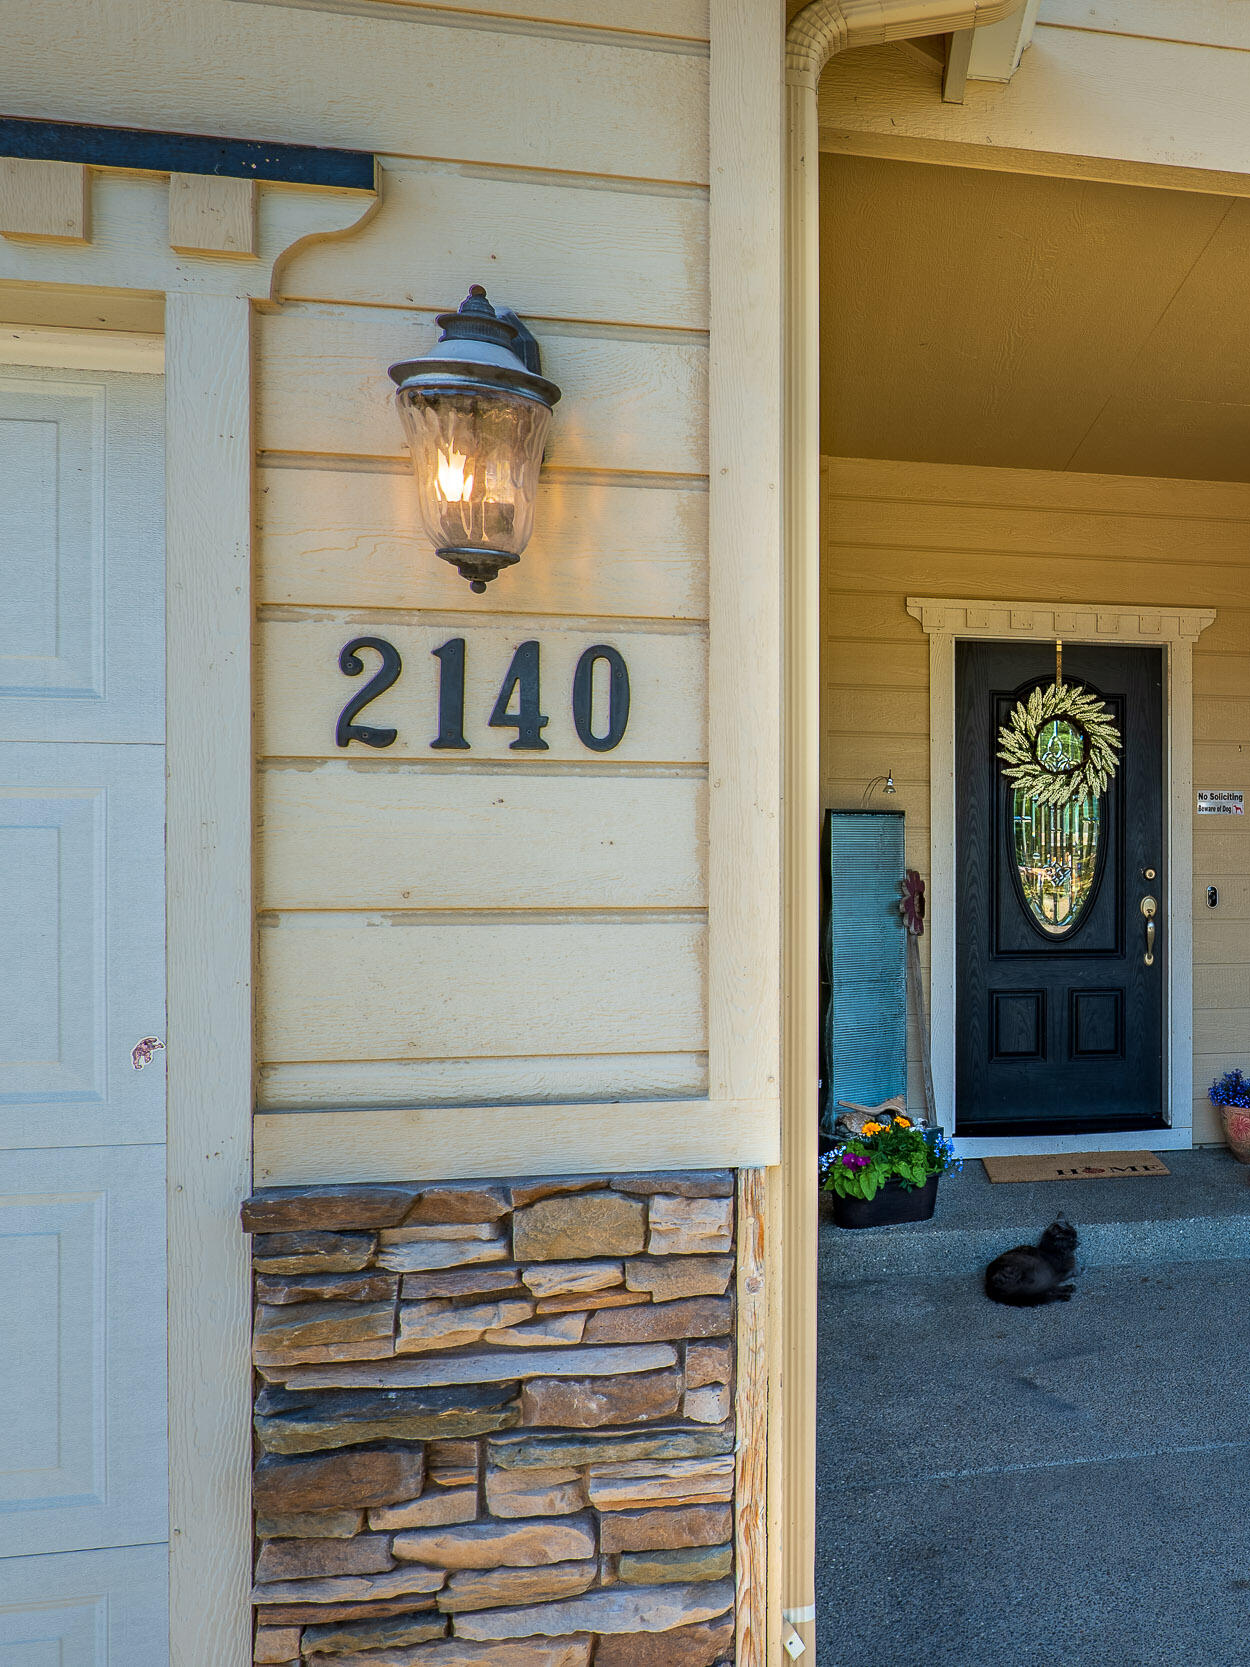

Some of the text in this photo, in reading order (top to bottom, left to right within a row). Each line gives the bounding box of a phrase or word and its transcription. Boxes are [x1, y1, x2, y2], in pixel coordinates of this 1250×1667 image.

[336, 636, 631, 752] 2140
[1198, 792, 1243, 802] No Soliciting
[1222, 805, 1232, 813] Dog
